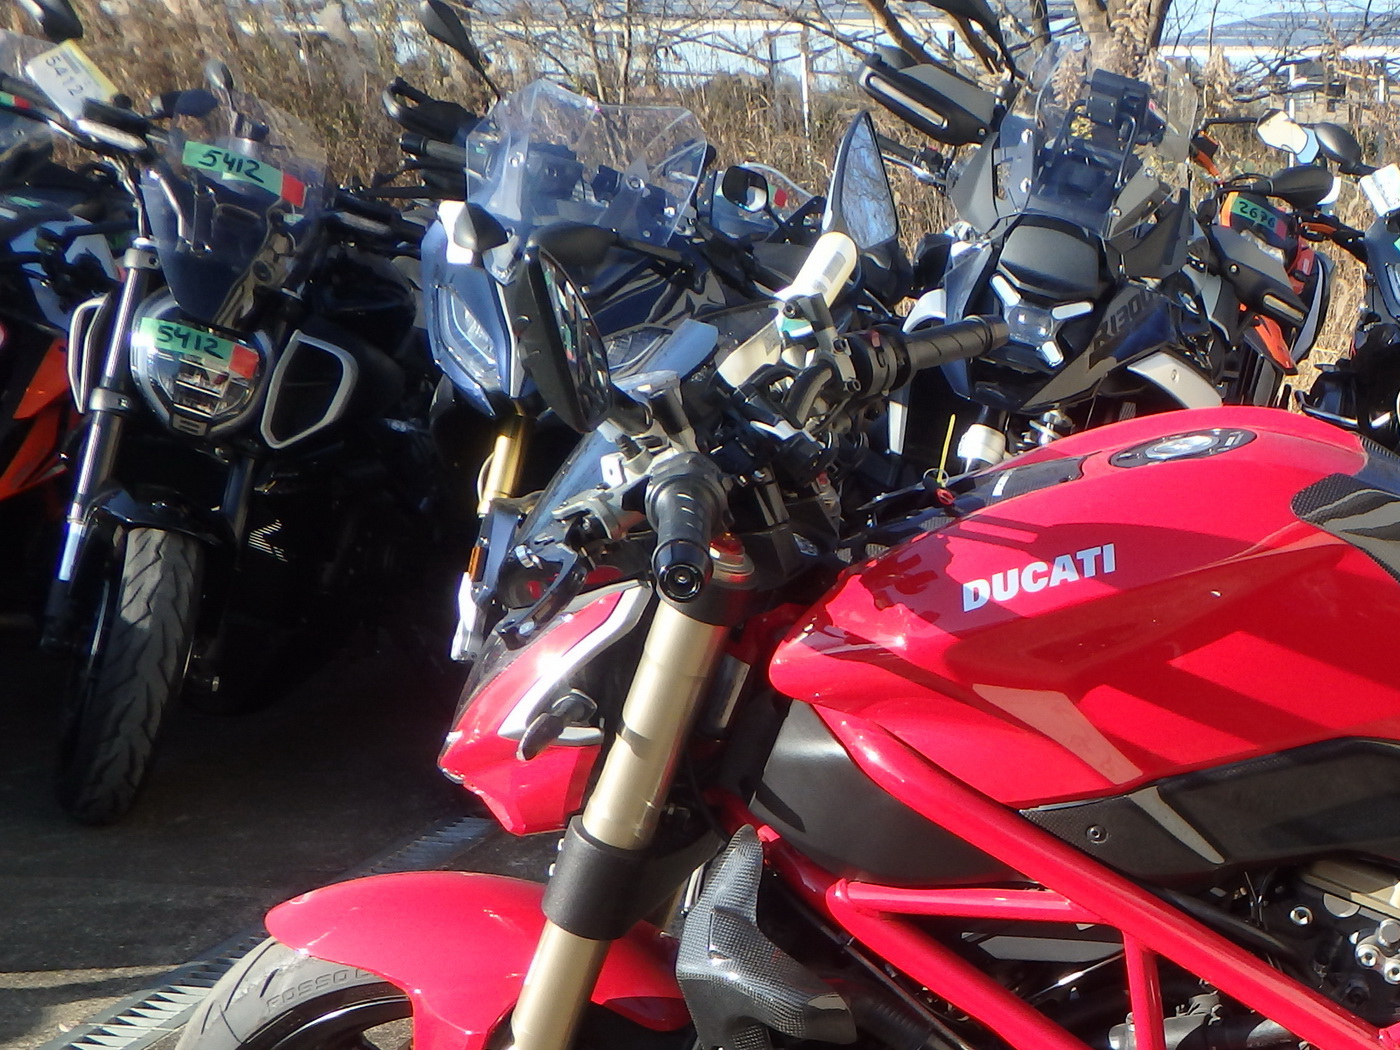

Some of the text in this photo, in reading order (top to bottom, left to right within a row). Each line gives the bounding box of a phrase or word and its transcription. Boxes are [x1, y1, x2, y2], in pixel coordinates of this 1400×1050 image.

[45, 55, 84, 97] 5412
[198, 149, 264, 183] 5412
[157, 325, 224, 359] 5412
[962, 543, 1115, 612] DUCATI
